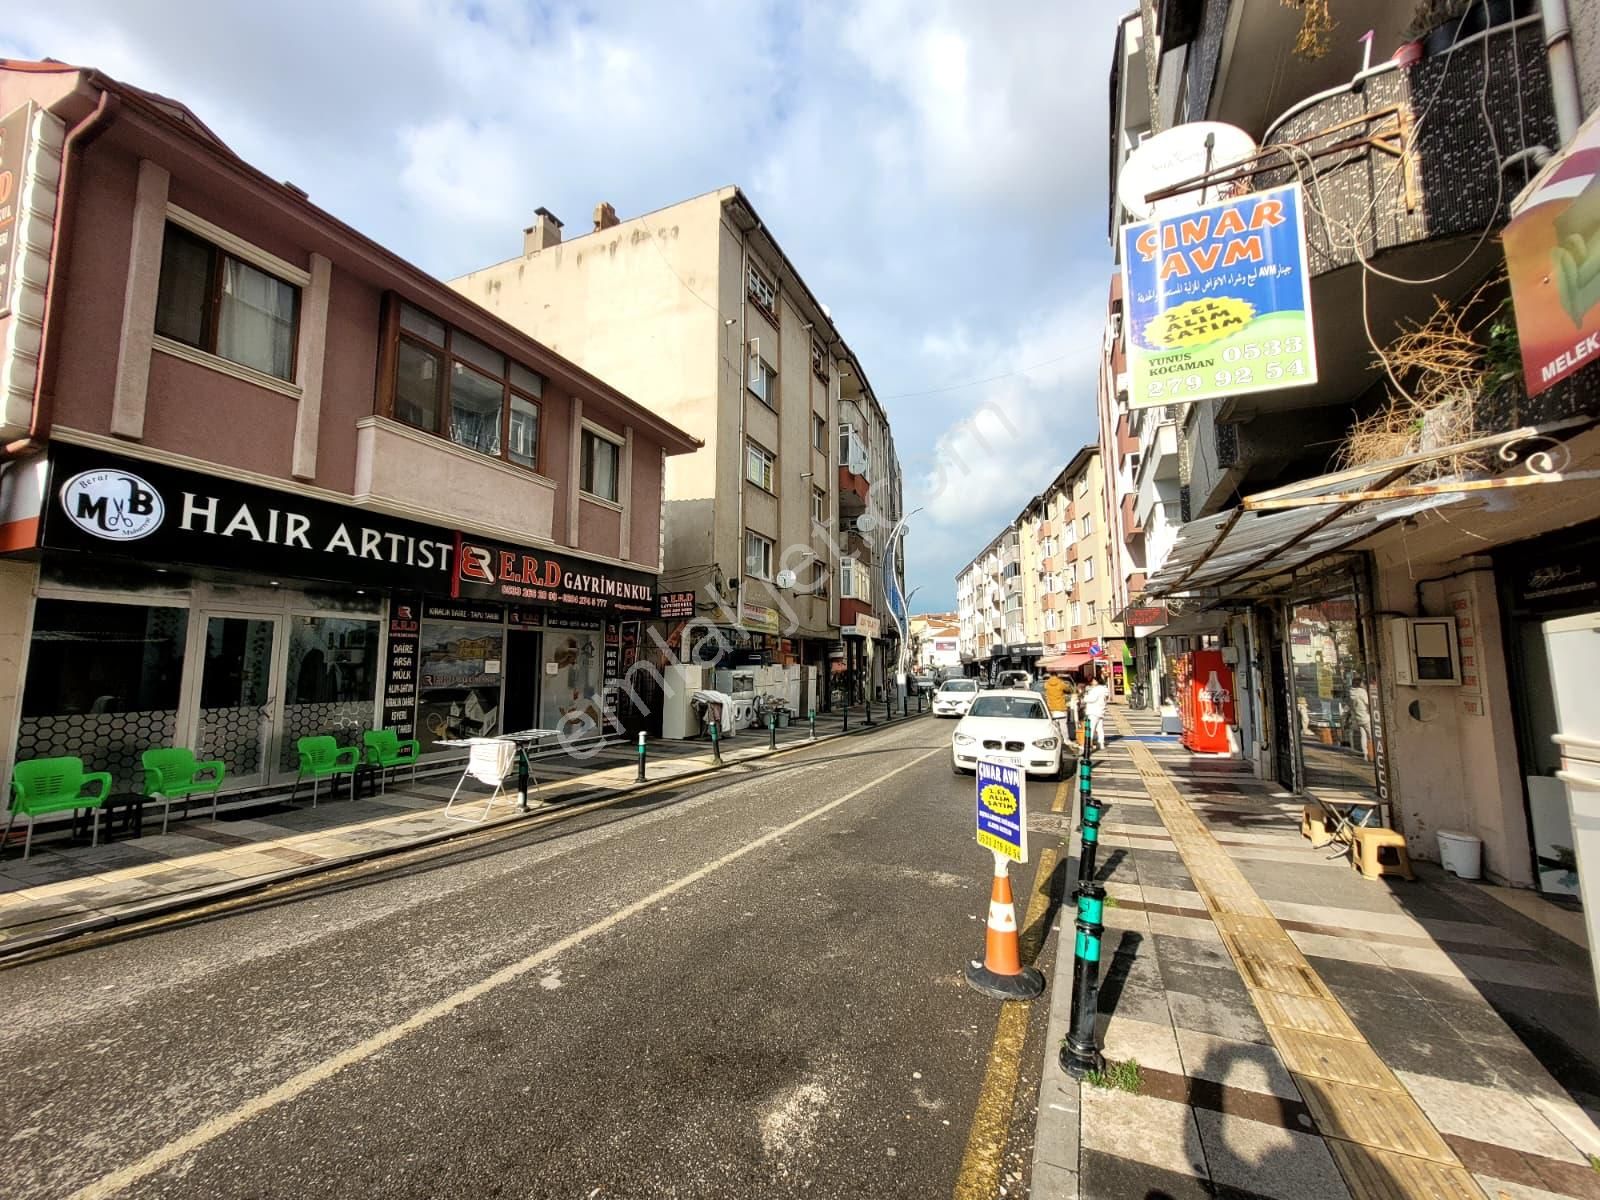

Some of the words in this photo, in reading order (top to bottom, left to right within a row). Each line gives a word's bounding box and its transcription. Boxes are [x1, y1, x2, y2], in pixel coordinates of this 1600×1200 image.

[1136, 200, 1287, 262] ÇINAR
[1159, 236, 1263, 281] AVM
[1259, 265, 1276, 277] AVM
[1163, 316, 1242, 344] SATIM
[1167, 310, 1231, 333] ALIM
[1149, 352, 1192, 367] YUNUS
[1222, 336, 1303, 363] 0533
[1541, 331, 1600, 382] MELEK
[1149, 359, 1215, 377] KOCAMAN
[1149, 374, 1203, 398] 279
[1215, 367, 1253, 387] 92
[1266, 359, 1305, 380] 54
[178, 491, 313, 550] HAIR
[323, 522, 453, 571] ARTIST
[499, 550, 562, 588] E.R.D
[563, 572, 653, 601] GAYRİMENKUL
[392, 643, 414, 654] DAİRE
[392, 656, 412, 667] ARSA
[392, 669, 411, 680] MÜLK
[1371, 695, 1388, 800] TOBACCO
